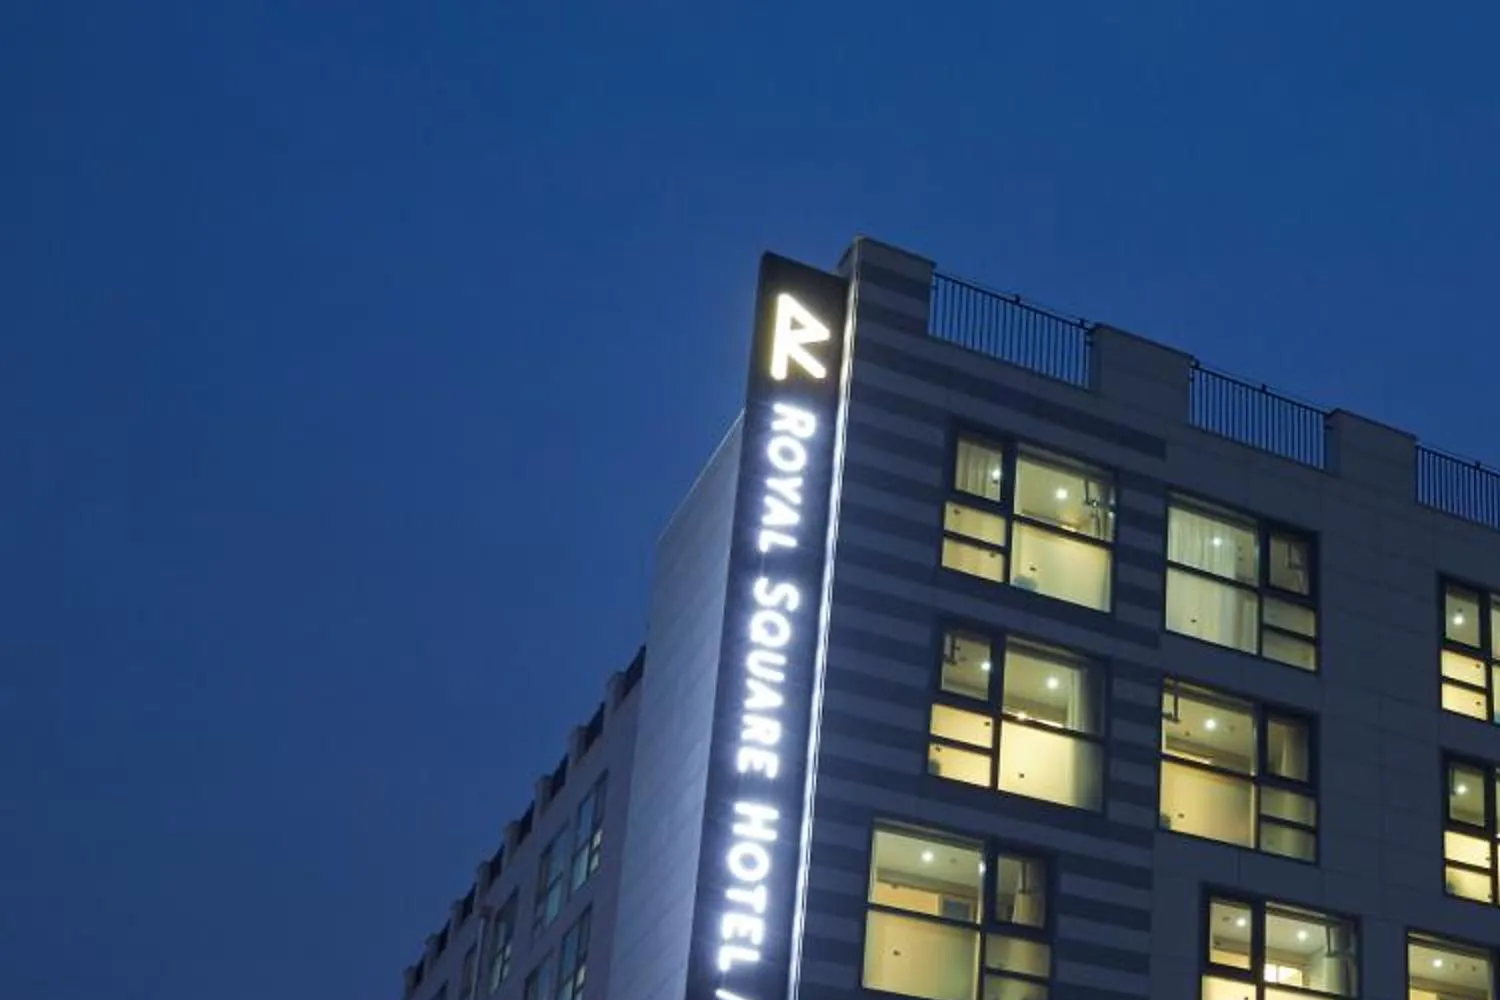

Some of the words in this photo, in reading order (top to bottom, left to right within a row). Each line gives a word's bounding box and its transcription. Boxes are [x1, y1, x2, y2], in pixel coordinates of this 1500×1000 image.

[758, 402, 817, 553] ROYAL
[736, 575, 801, 780] SQUARE
[716, 800, 779, 972] HOTEL
